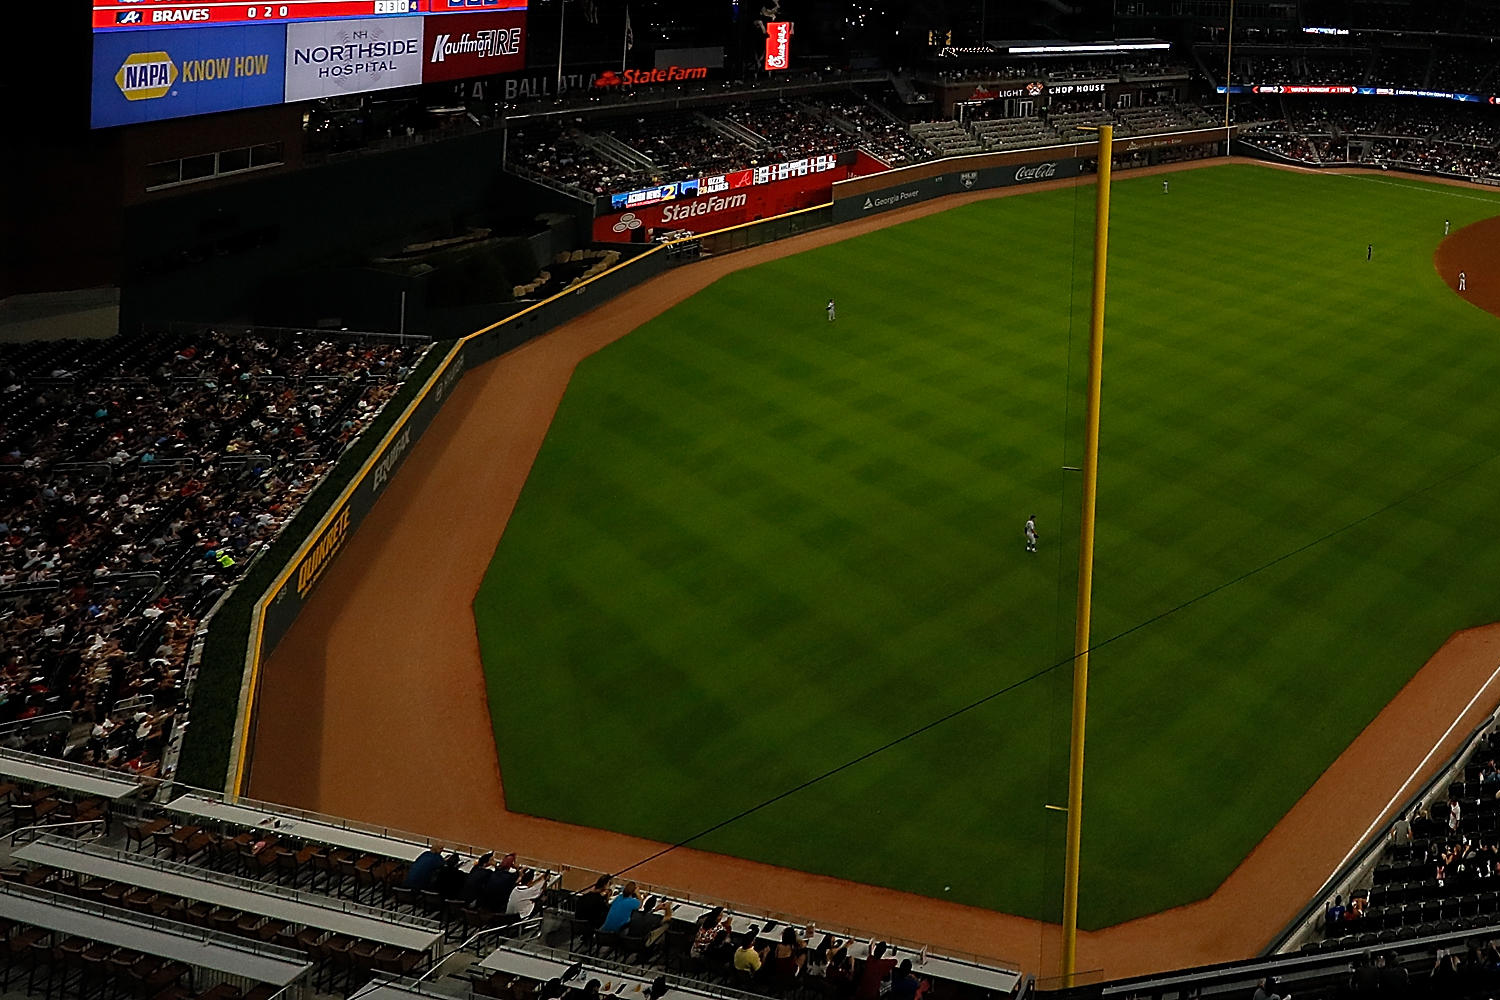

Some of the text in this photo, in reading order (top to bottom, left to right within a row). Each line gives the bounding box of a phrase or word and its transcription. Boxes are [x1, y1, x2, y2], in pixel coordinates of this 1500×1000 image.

[152, 9, 209, 22] BRAVES
[247, 7, 257, 18] 0
[263, 6, 272, 17] 2
[279, 6, 288, 16] 0
[378, 2, 384, 11] 2
[390, 2, 395, 11] 3
[401, 1, 406, 10] 0
[410, 1, 418, 10] 4
[294, 39, 418, 65] NORTHSIDE
[431, 28, 521, 63] Kauffman TIRE
[125, 55, 268, 88] NAPA KNOW HOW
[318, 60, 397, 79] HOSPITAL
[505, 77, 550, 100] BALL
[1000, 89, 1023, 97] LIGHT
[1049, 84, 1105, 94] CHOP HOUSE
[662, 186, 676, 201] 2
[874, 189, 920, 208] Georgia Power
